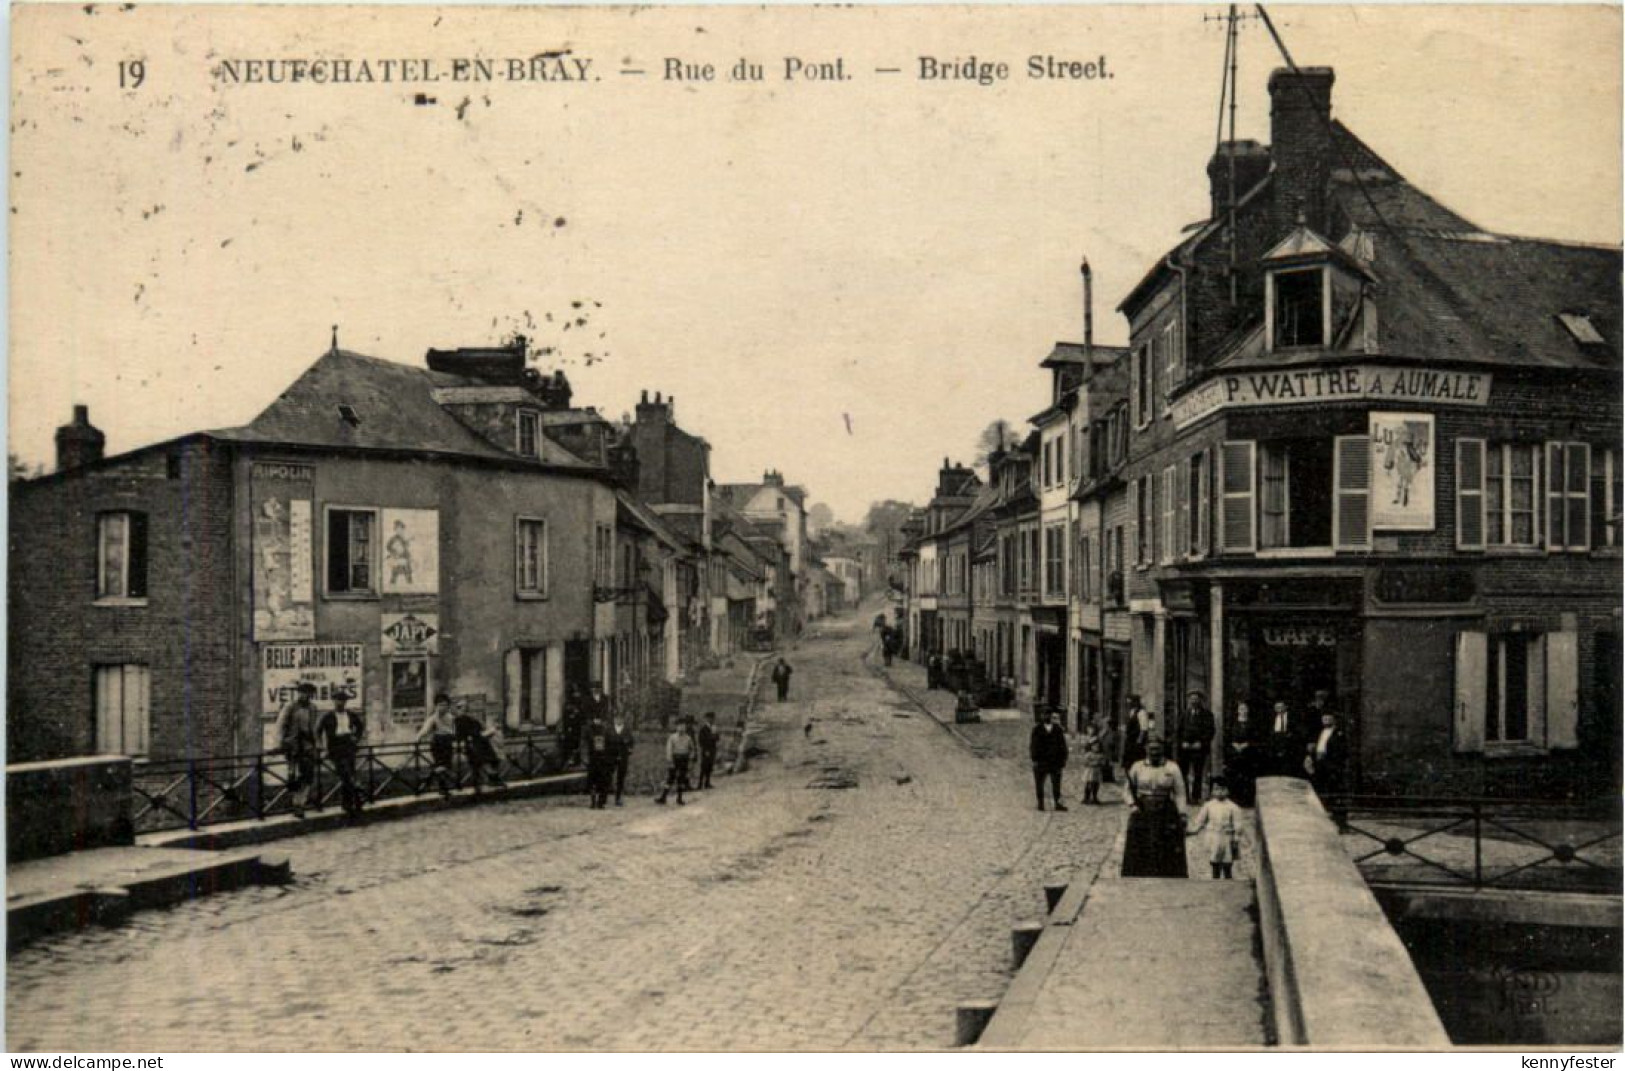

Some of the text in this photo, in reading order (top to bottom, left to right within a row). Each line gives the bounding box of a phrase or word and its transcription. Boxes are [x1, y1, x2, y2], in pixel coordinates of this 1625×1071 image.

[1226, 374, 1246, 402] P.
[1248, 368, 1362, 400] WATTRE
[1393, 371, 1482, 399] AUMALE
[389, 622, 428, 642] JAPY
[266, 647, 296, 669] BELLE
